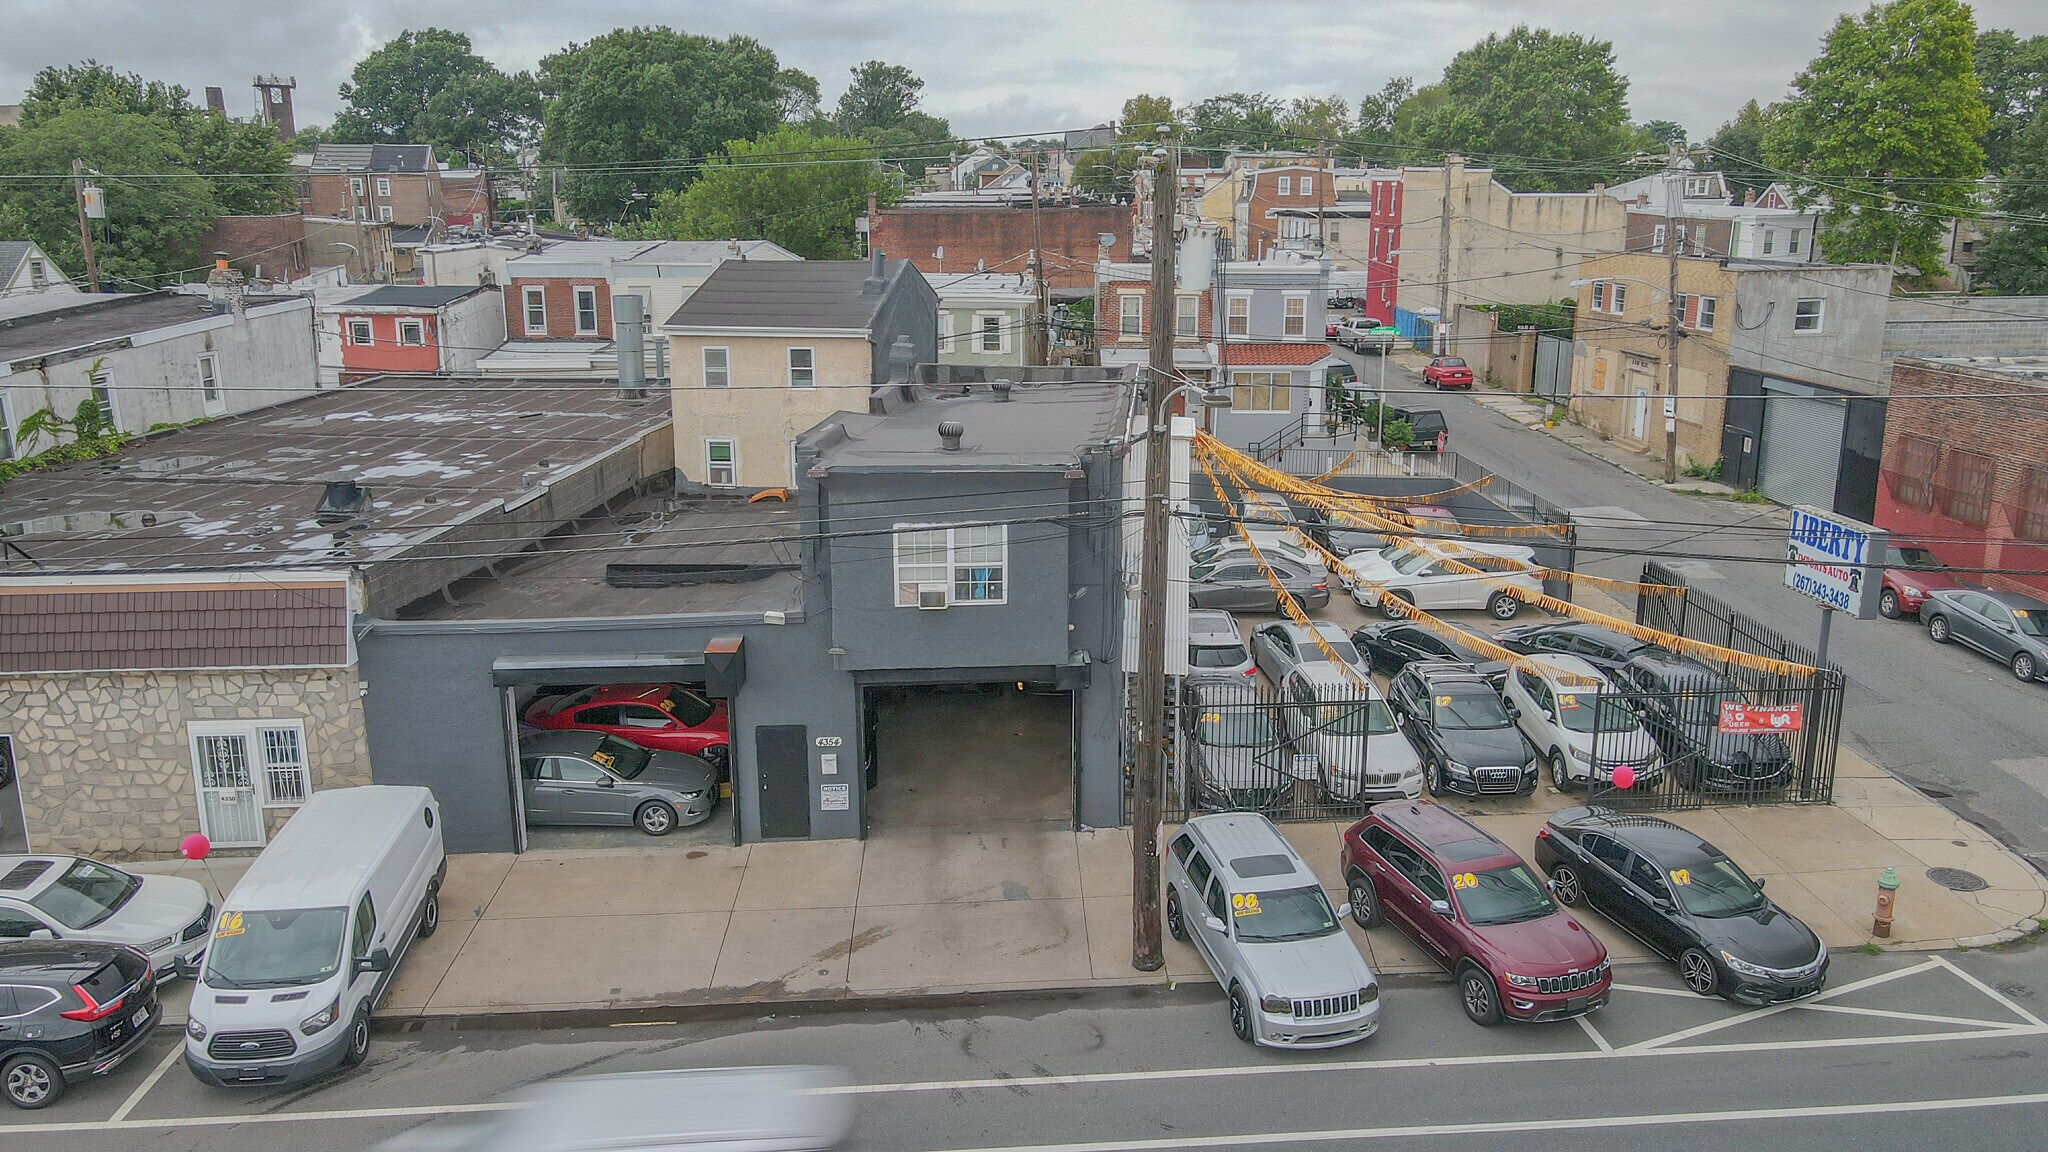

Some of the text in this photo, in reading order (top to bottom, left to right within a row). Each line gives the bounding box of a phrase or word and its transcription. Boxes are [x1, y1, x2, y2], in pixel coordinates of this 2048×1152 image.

[1789, 510, 1868, 564] LIBERTY
[1798, 553, 1849, 582] IMPORTS AUTO
[1793, 571, 1850, 610] (267)343-3438
[1724, 703, 1799, 712] WE FINANCE
[817, 738, 841, 746] 4354
[1452, 872, 1479, 890] 20
[1669, 869, 1692, 886] 17
[1232, 893, 1259, 910] 08
[219, 911, 243, 930] 16
